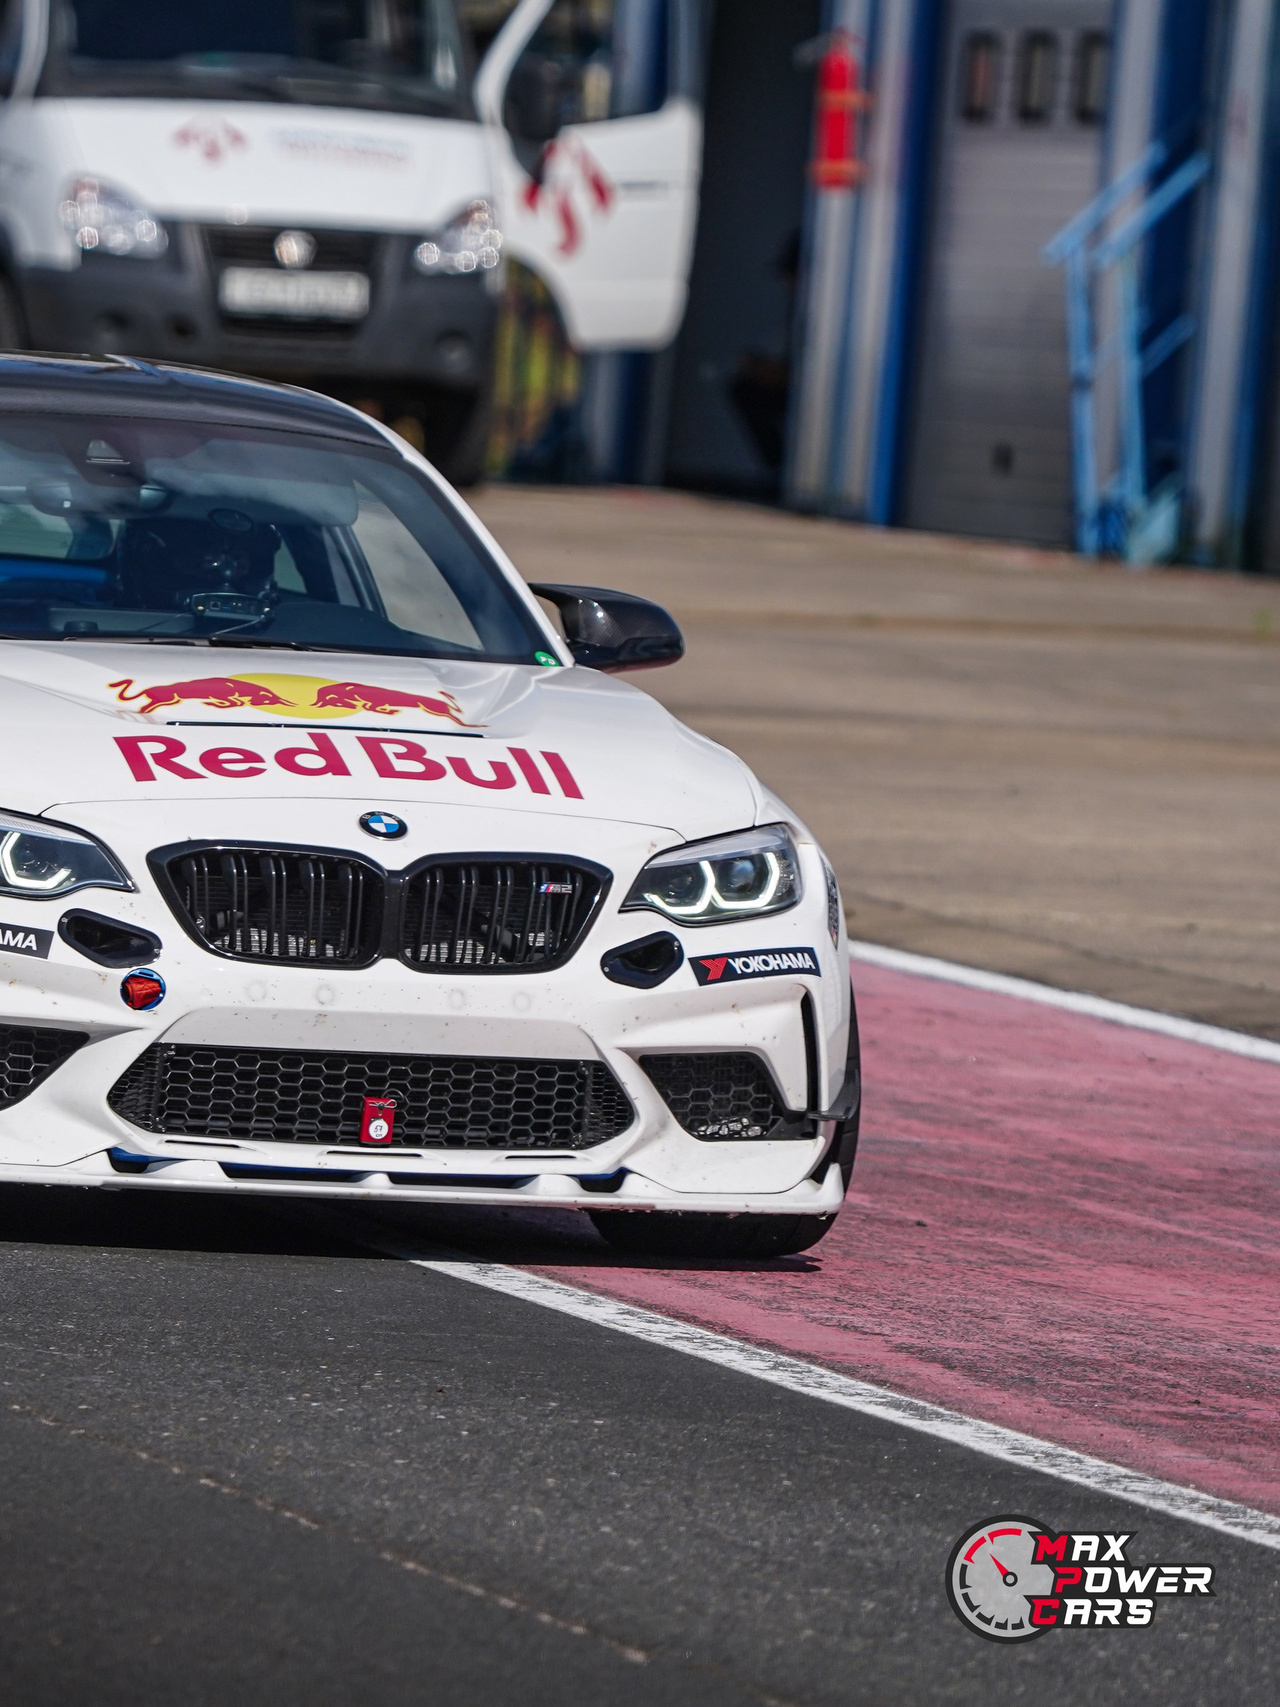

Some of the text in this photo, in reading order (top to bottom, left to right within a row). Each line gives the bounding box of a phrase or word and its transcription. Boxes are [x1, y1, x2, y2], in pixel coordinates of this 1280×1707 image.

[112, 732, 585, 800] Red Bull
[728, 952, 816, 974] YOKOHAMA
